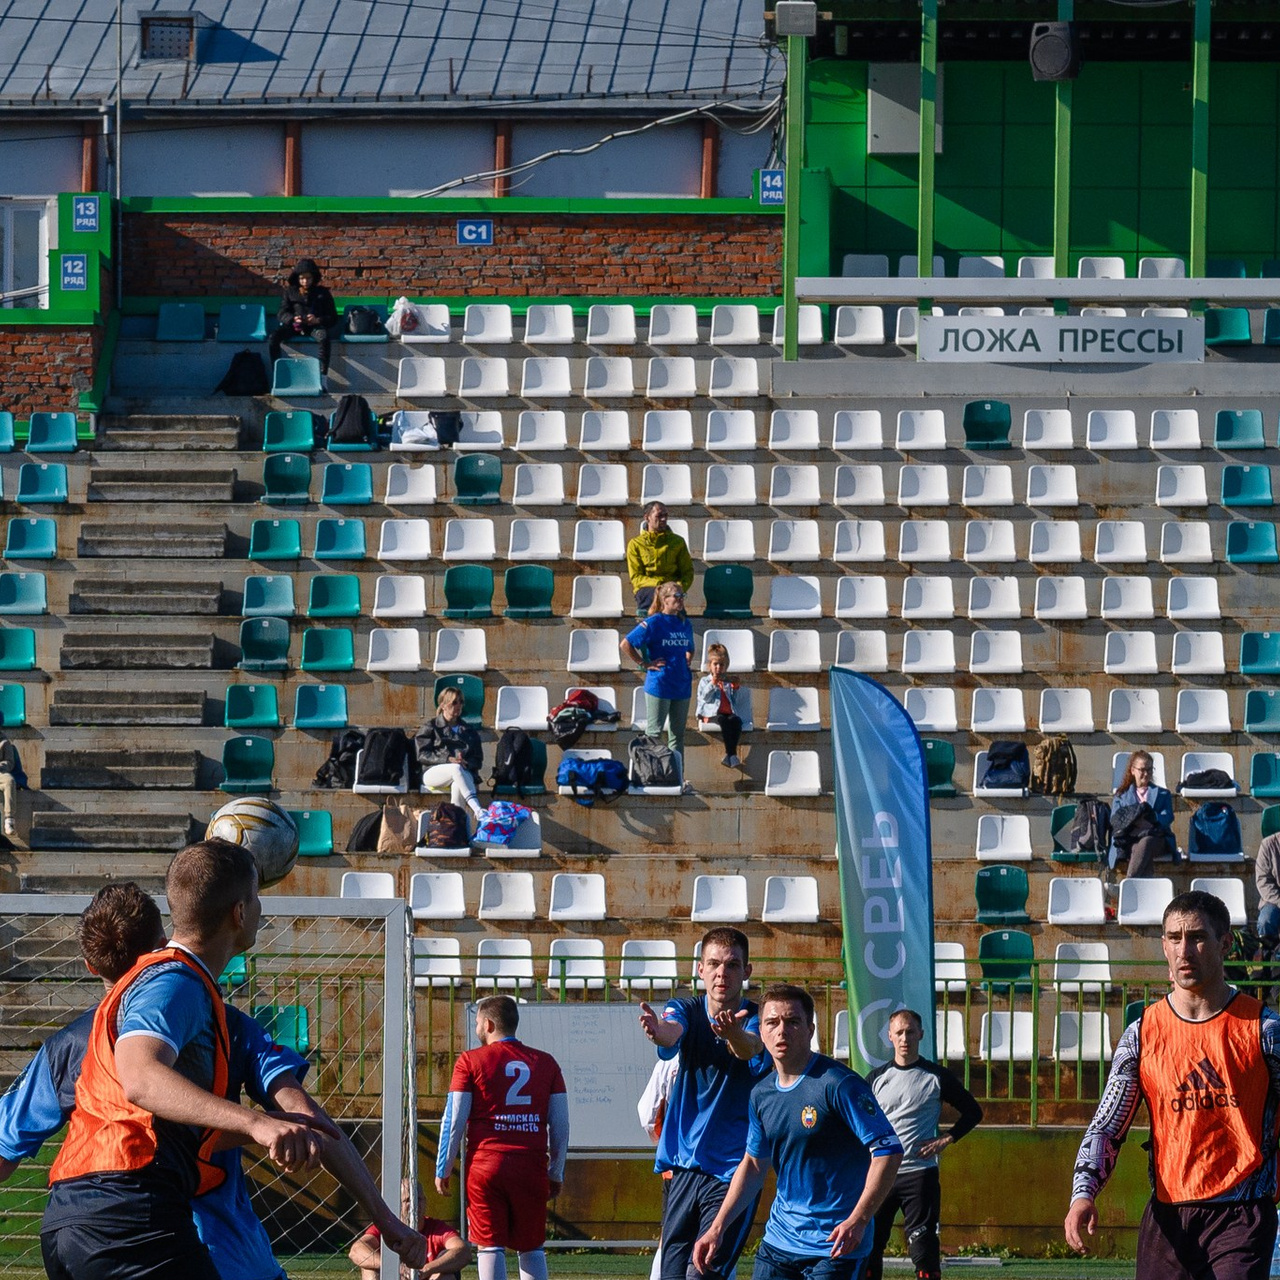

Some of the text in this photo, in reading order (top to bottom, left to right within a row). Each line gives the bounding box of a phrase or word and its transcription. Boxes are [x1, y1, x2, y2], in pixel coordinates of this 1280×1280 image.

[763, 175, 782, 188] 14
[763, 191, 783, 200] РЯД
[77, 202, 95, 215] 13
[76, 218, 96, 226] РЯД
[463, 225, 487, 240] С1
[64, 260, 83, 273] 12
[64, 276, 84, 285] РЯД
[939, 328, 1184, 353] ЛОЖА ПРЕССЫ
[505, 1060, 531, 1106] 2
[1171, 1086, 1240, 1112] adidas
